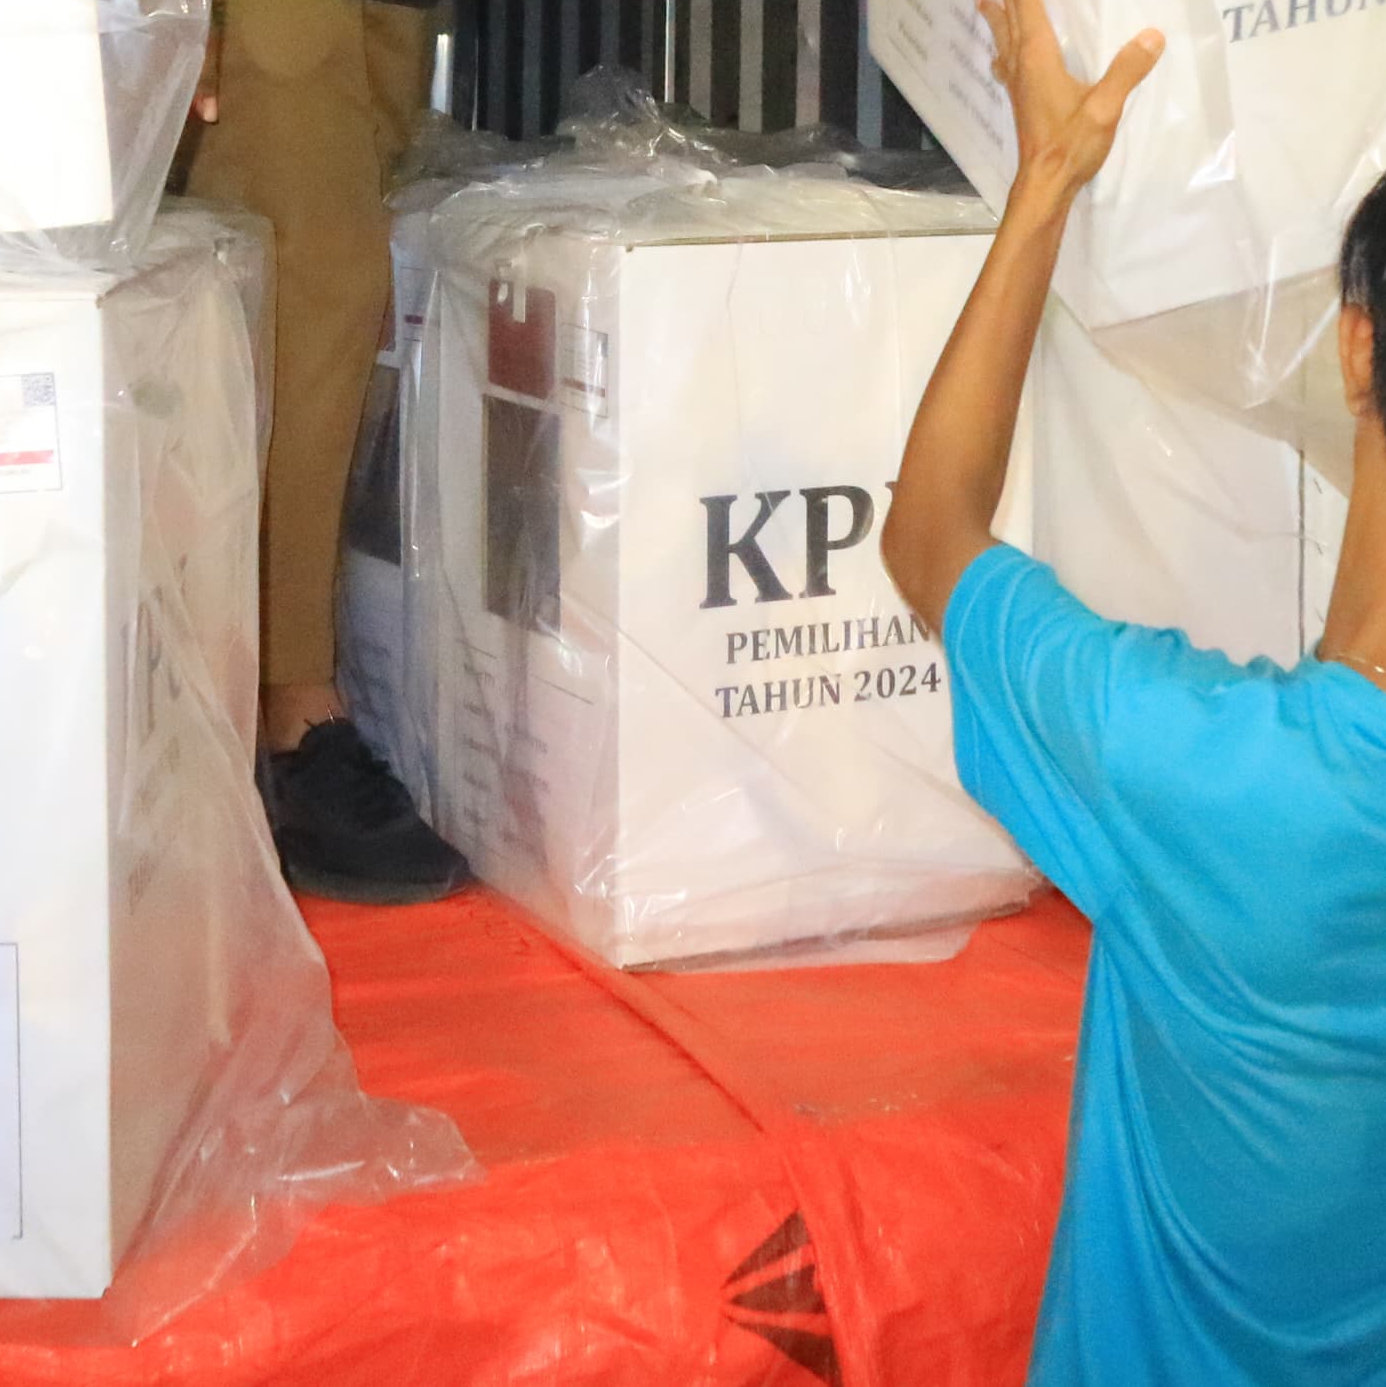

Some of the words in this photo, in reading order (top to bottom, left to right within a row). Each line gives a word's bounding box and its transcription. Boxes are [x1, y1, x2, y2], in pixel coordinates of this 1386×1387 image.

[699, 481, 898, 609] KP
[726, 614, 930, 665] PEMILIHAN
[715, 673, 842, 718] TAHUN
[853, 662, 941, 702] 2024
